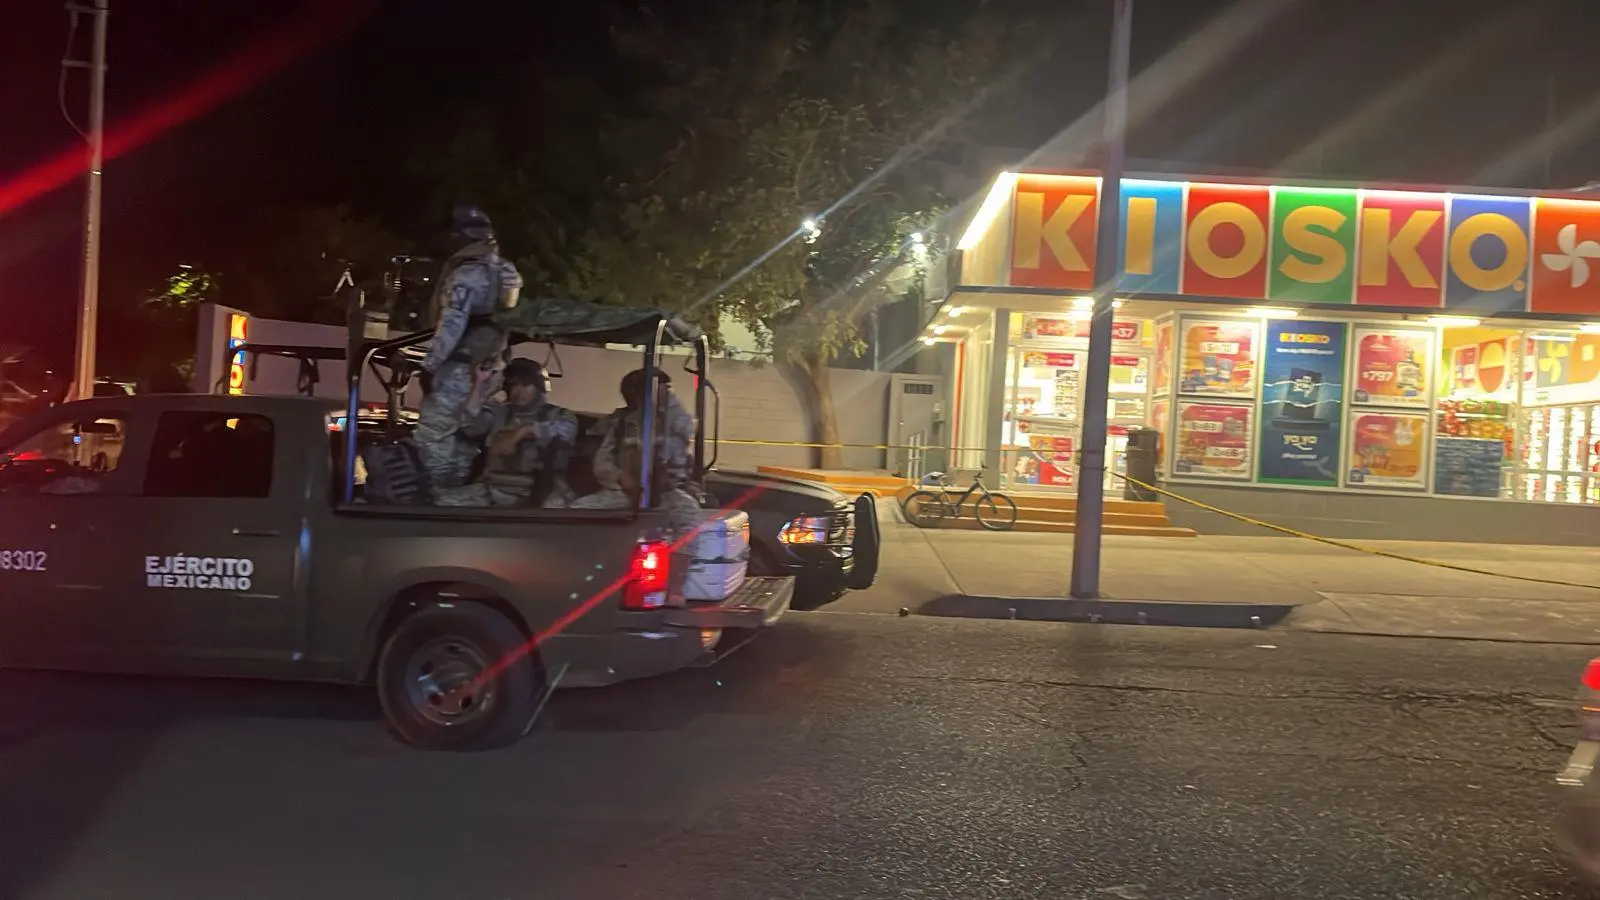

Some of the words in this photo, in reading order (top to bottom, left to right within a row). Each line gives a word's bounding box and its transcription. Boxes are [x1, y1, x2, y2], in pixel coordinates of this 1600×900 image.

[1012, 190, 1528, 293] KIOSKO
[0, 550, 47, 571] 8302
[145, 552, 254, 577] EJÉRCITO
[146, 574, 252, 591] MEXICANO
